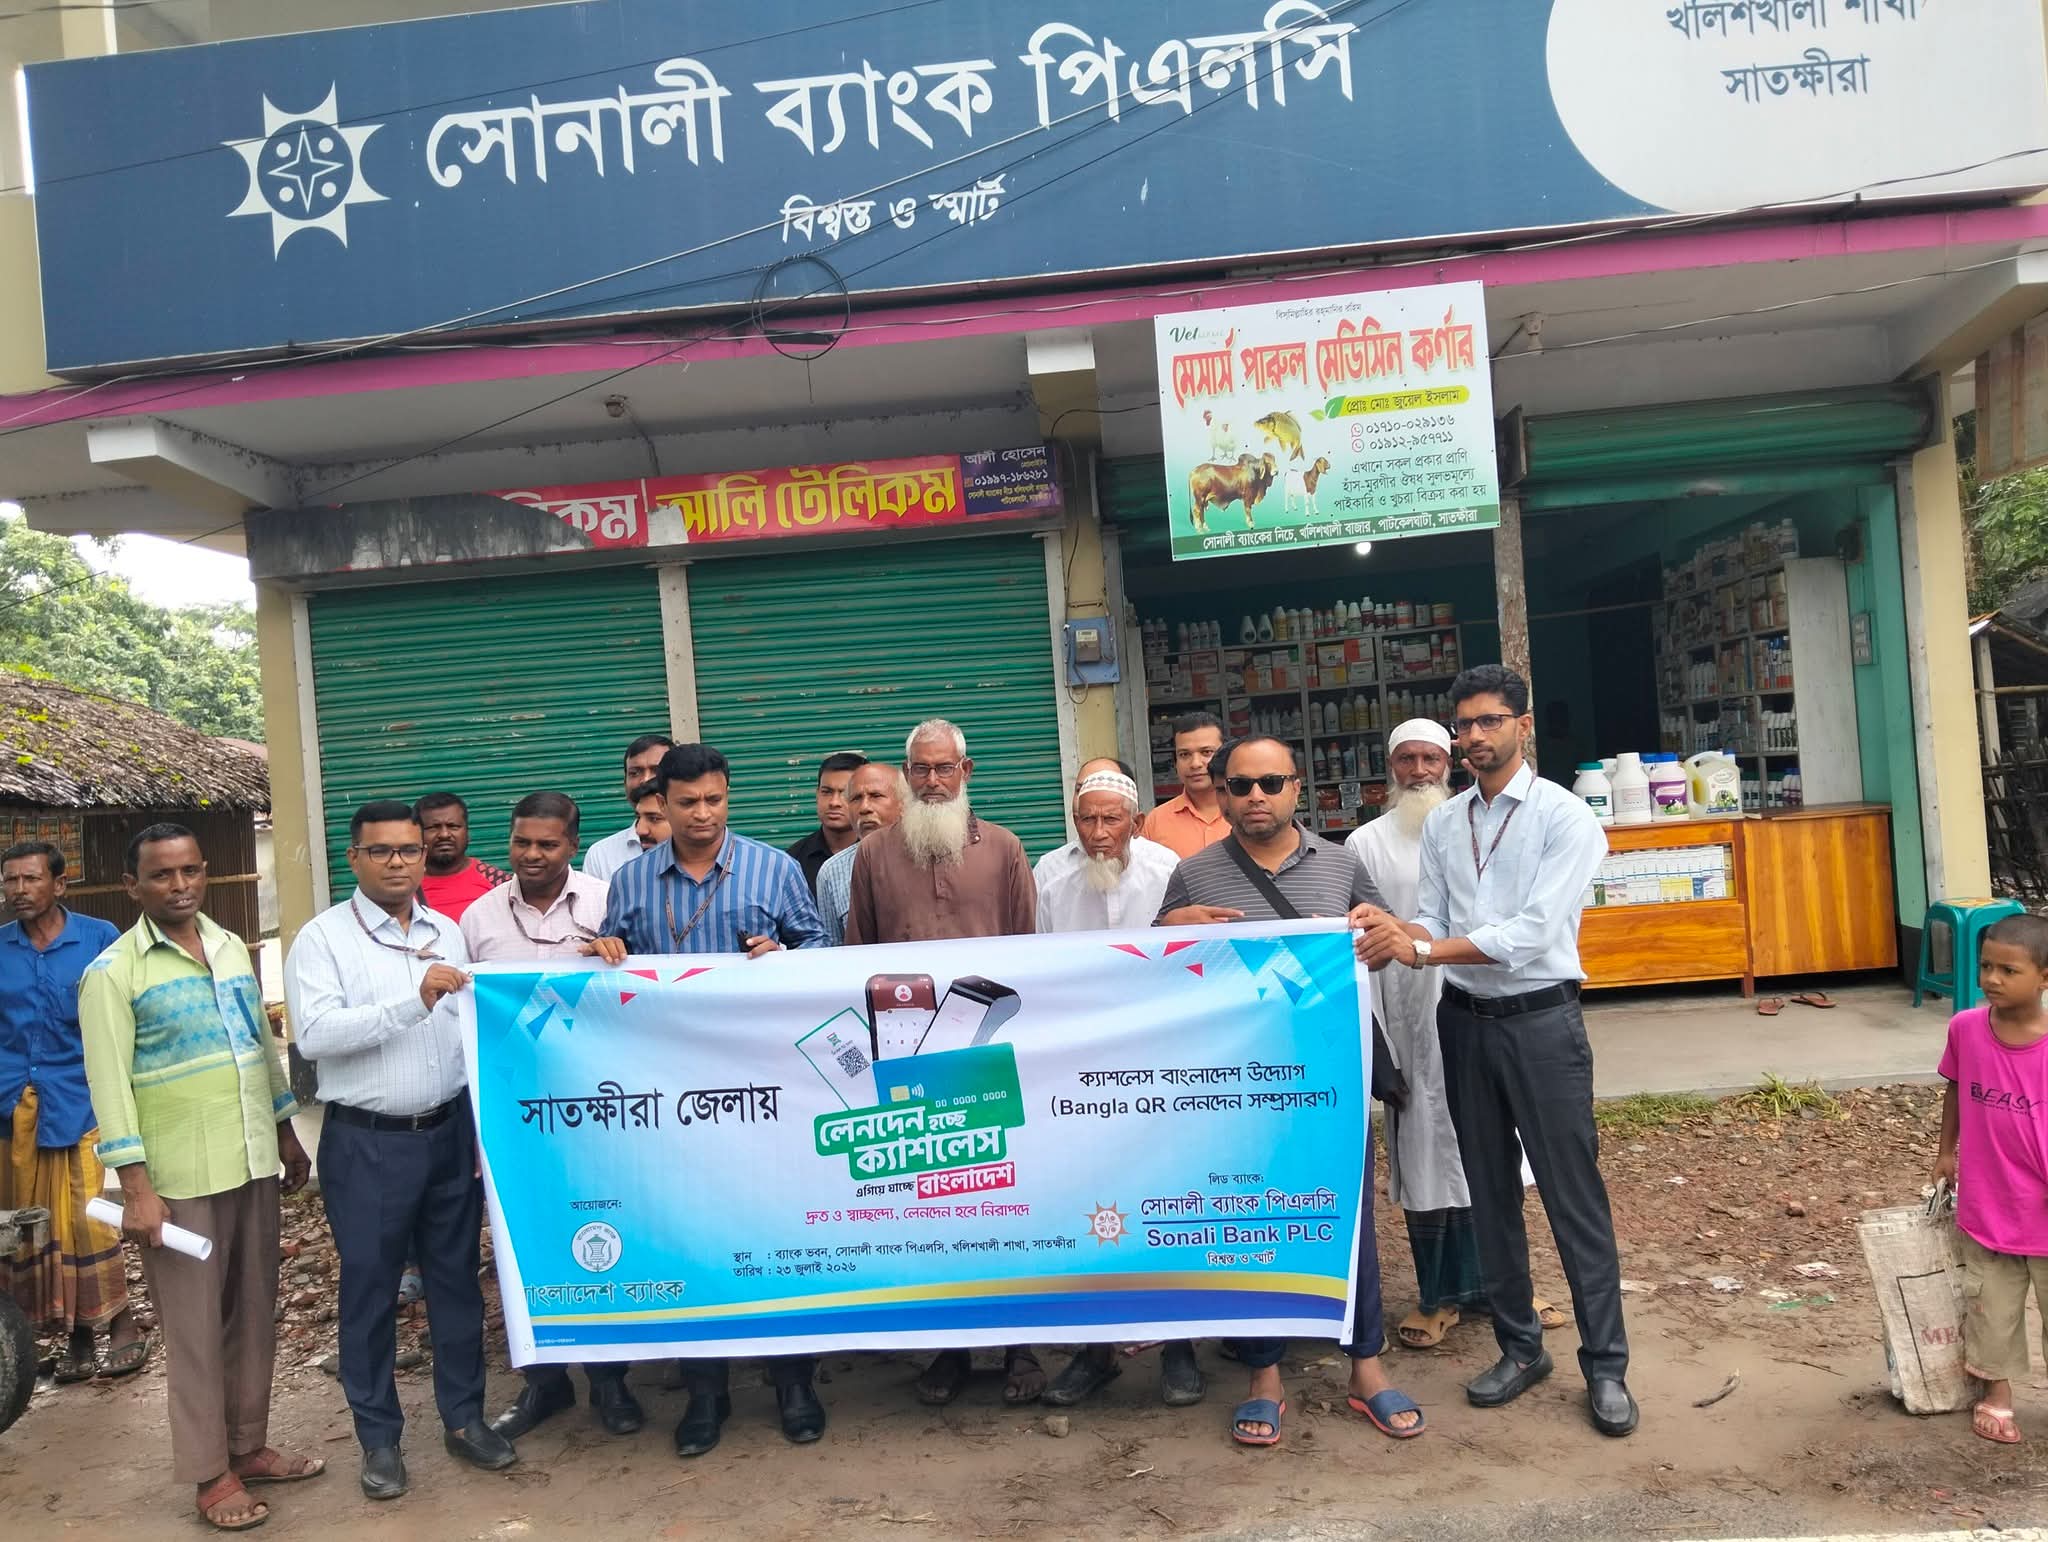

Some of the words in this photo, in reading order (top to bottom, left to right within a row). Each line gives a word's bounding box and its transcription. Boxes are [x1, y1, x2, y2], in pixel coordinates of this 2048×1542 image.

[1720, 47, 1871, 103] সাতক্ষীরা
[426, 58, 732, 188] সোনালী
[753, 59, 997, 156] ব্যাংক
[1018, 0, 1361, 130] পিএলসি
[780, 194, 876, 244] বিশ্বস্ত
[889, 197, 917, 229] ও
[928, 173, 1006, 227] স্মার্ট
[1173, 327, 1235, 408] মেসার্স
[1240, 342, 1307, 391] পারুল
[1316, 315, 1402, 393] মেডিসিন
[1409, 304, 1474, 372] কর্ণার
[1393, 394, 1421, 410] জুয়েল
[1425, 390, 1460, 404] ইসলাম
[1352, 460, 1383, 474] এখানে
[1387, 457, 1411, 471] সকল
[1415, 454, 1442, 467] প্রকার
[775, 464, 956, 529] টেলিকম
[1334, 493, 1374, 511] পাইকারি
[1449, 486, 1468, 499] করা
[1472, 484, 1487, 497] হয়
[1203, 530, 1235, 550] সোনালী
[1079, 1069, 1154, 1087] ক্যাশলেস
[1160, 1066, 1241, 1088] বাংলাদেশ
[1247, 1061, 1306, 1081] উদ্যোগ
[517, 1080, 664, 1135] সাতক্ষীরা
[677, 1081, 784, 1126] জেলায়
[1051, 1096, 1129, 1119] (Bangla
[1135, 1096, 1166, 1115] QR
[1172, 1093, 1242, 1112] লেনদেন
[1247, 1086, 1338, 1112] সম্প্রসারণ)
[820, 1106, 925, 1147] লেনদেন
[928, 1110, 968, 1132] হচ্ছে
[853, 1125, 1002, 1174] ক্যাশলেস
[856, 1182, 885, 1198] এগিয়ে
[918, 1163, 1013, 1196] বাংলাদেশ
[1208, 1172, 1229, 1185] লিড
[806, 1210, 829, 1225] দ্রুত
[832, 1210, 842, 1222] ও
[903, 1205, 951, 1219] লেনদেন
[955, 1205, 977, 1218] হবে
[981, 1201, 1031, 1218] নিরাপদে
[1141, 1191, 1204, 1217] সোনালী
[1211, 1194, 1261, 1214] ব্যাংক
[1265, 1186, 1337, 1213] পিএলসি
[775, 1248, 803, 1260] ব্যাংক
[806, 1247, 832, 1259] ভবন,
[836, 1241, 872, 1257] সোনালী
[875, 1244, 903, 1256] ব্যাংক
[905, 1240, 948, 1255] পিএলসি,
[951, 1238, 1000, 1252] খলিশখালী
[1003, 1239, 1029, 1252] শাখা,
[1033, 1235, 1077, 1250] সাতক্ষীরা
[1147, 1227, 1216, 1248] Sonali
[1223, 1225, 1280, 1245] Bank
[1287, 1223, 1334, 1243] PLC
[733, 1264, 763, 1278] তারিখ
[776, 1265, 791, 1276] ২৩
[794, 1261, 823, 1276] জুলাই
[826, 1261, 857, 1273] ২০২৬
[1240, 1254, 1249, 1264] ও
[524, 1281, 615, 1307] াংলাদেশ
[621, 1278, 687, 1304] ব্যাংক
